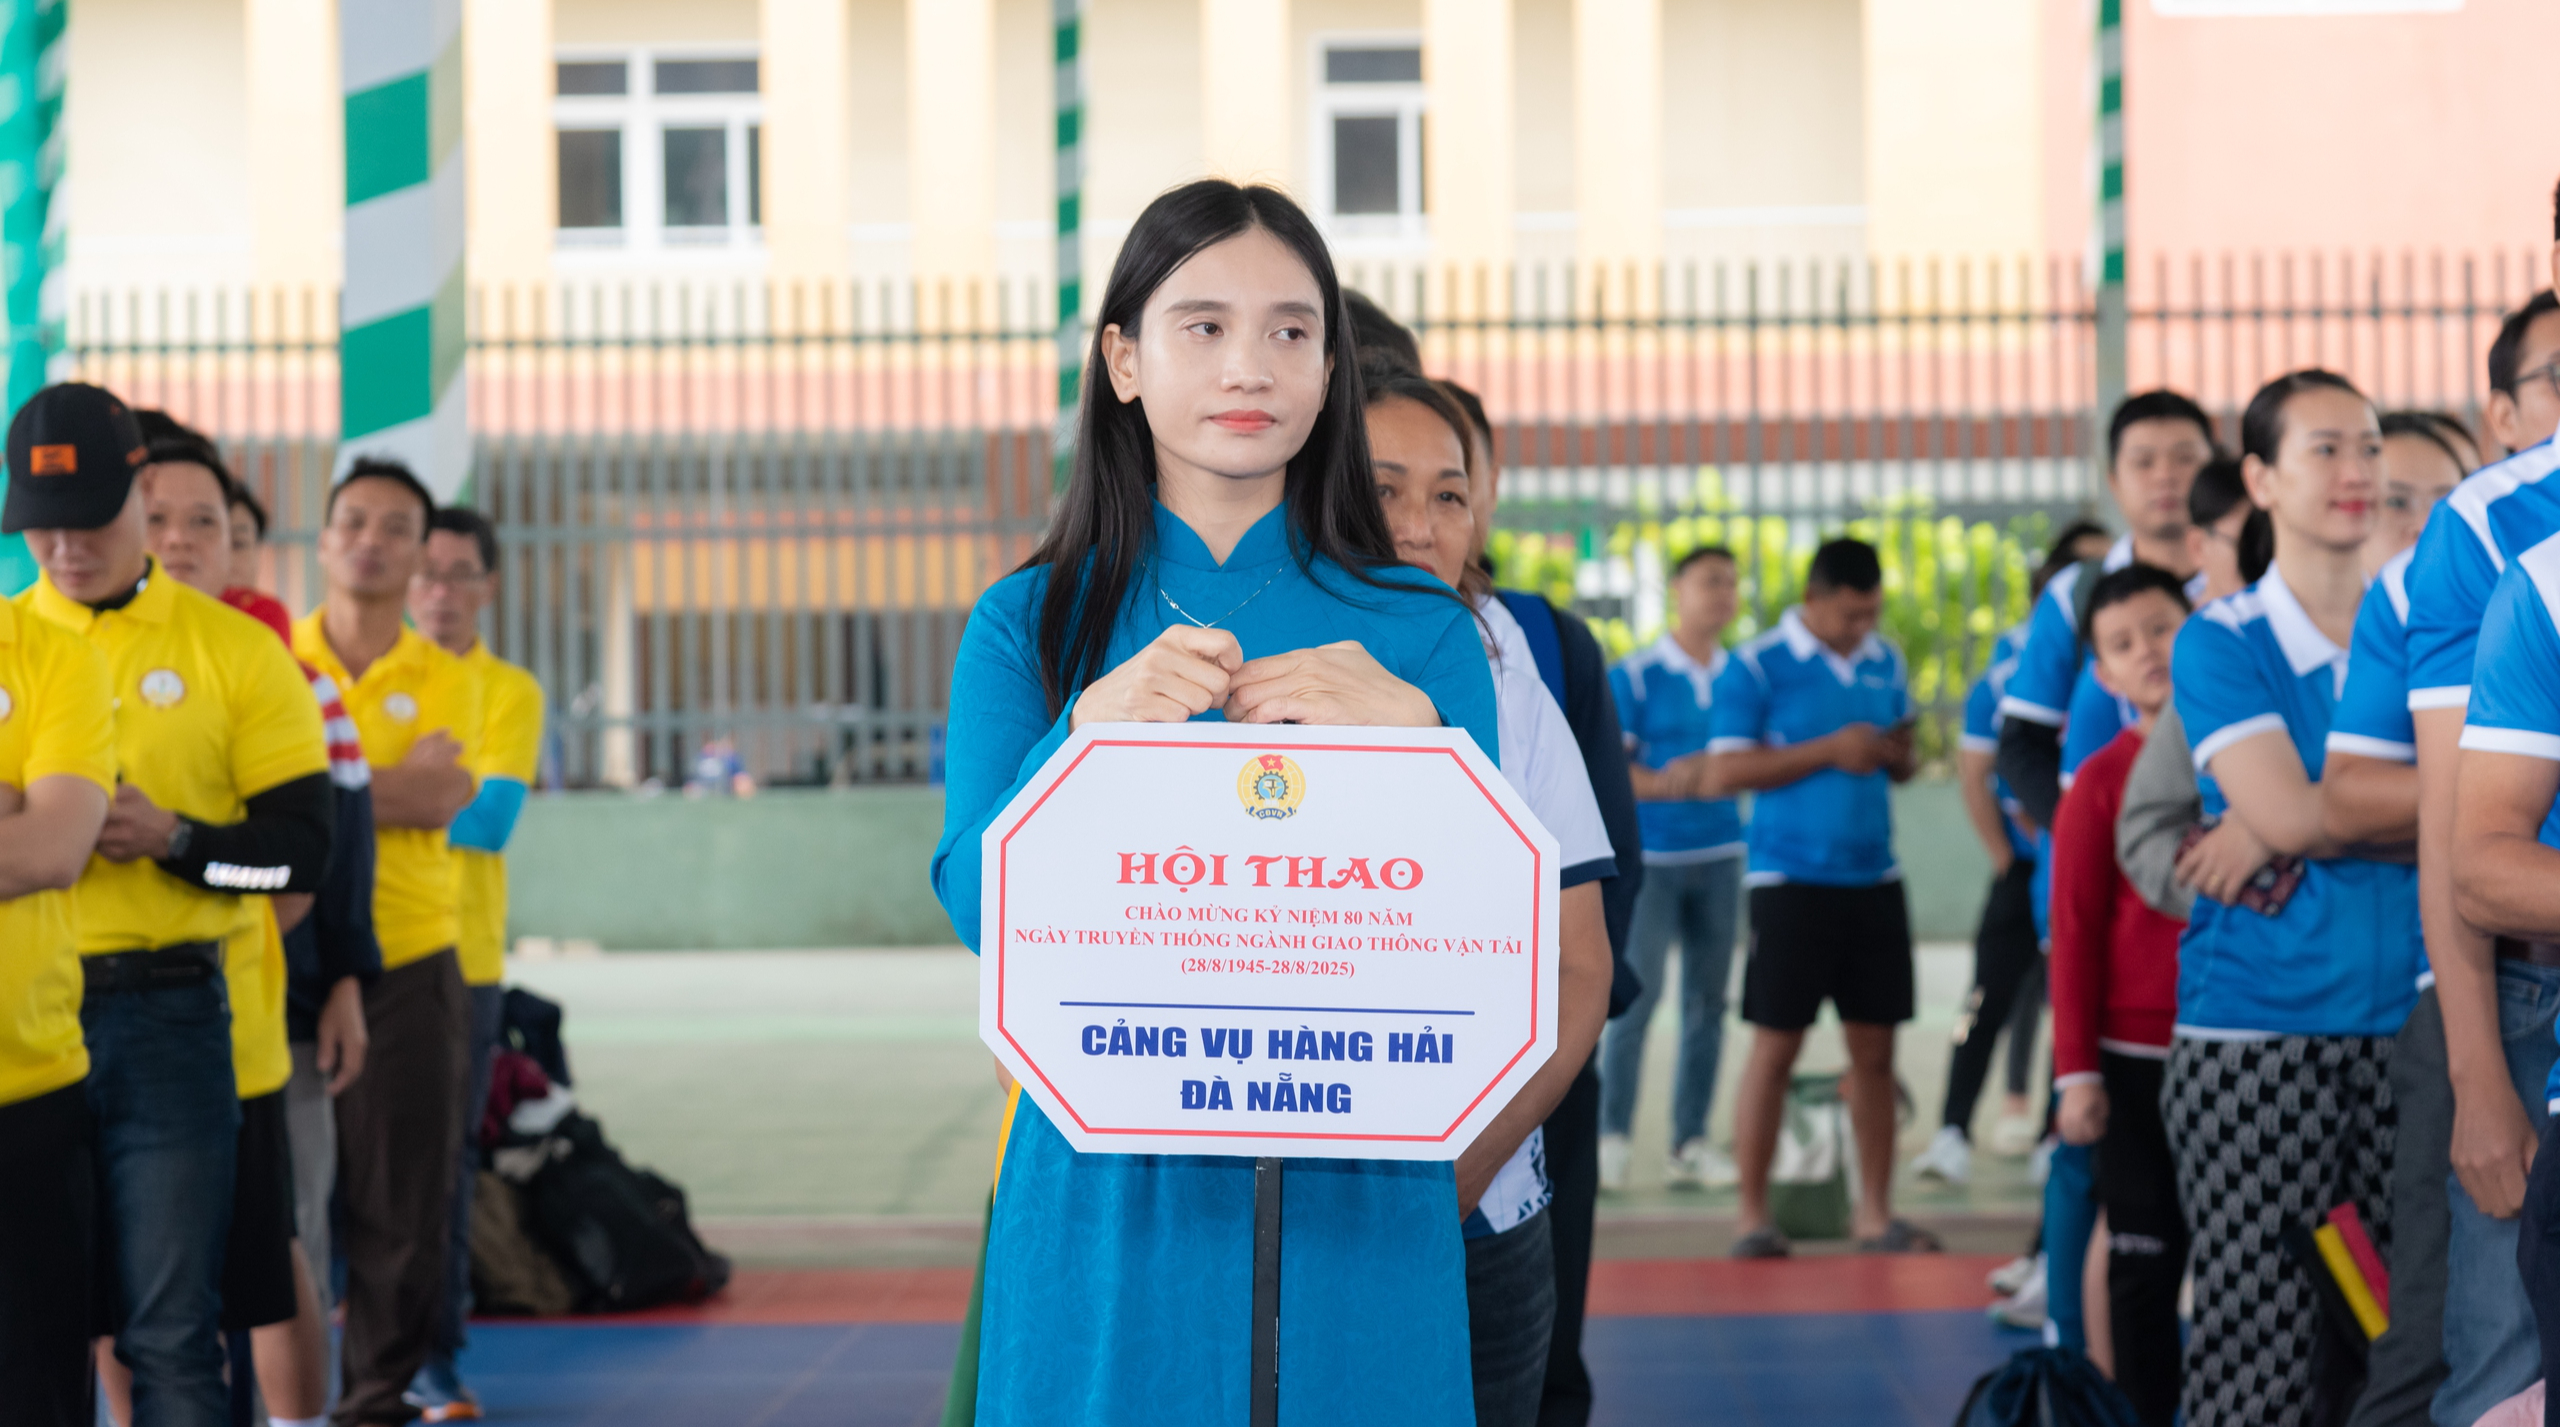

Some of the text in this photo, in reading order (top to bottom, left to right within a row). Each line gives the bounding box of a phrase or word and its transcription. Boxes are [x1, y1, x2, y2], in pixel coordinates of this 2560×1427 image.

[1116, 844, 1424, 894] HỘI THAO
[1124, 902, 1413, 928] CHÀO MỪNG KỶ NIỆM 80 NĂM
[1015, 925, 1523, 957] NGÀY TRUYỀN THỐNG NGÀNH GIAO THÔNG VẬN TẢI
[1180, 957, 1356, 977] (28/8/1945-28/8/2025)
[1081, 1018, 1454, 1066] CẢNG VỤ HÀNG HẢI
[1180, 1072, 1352, 1115] ĐÀ NẴNG
